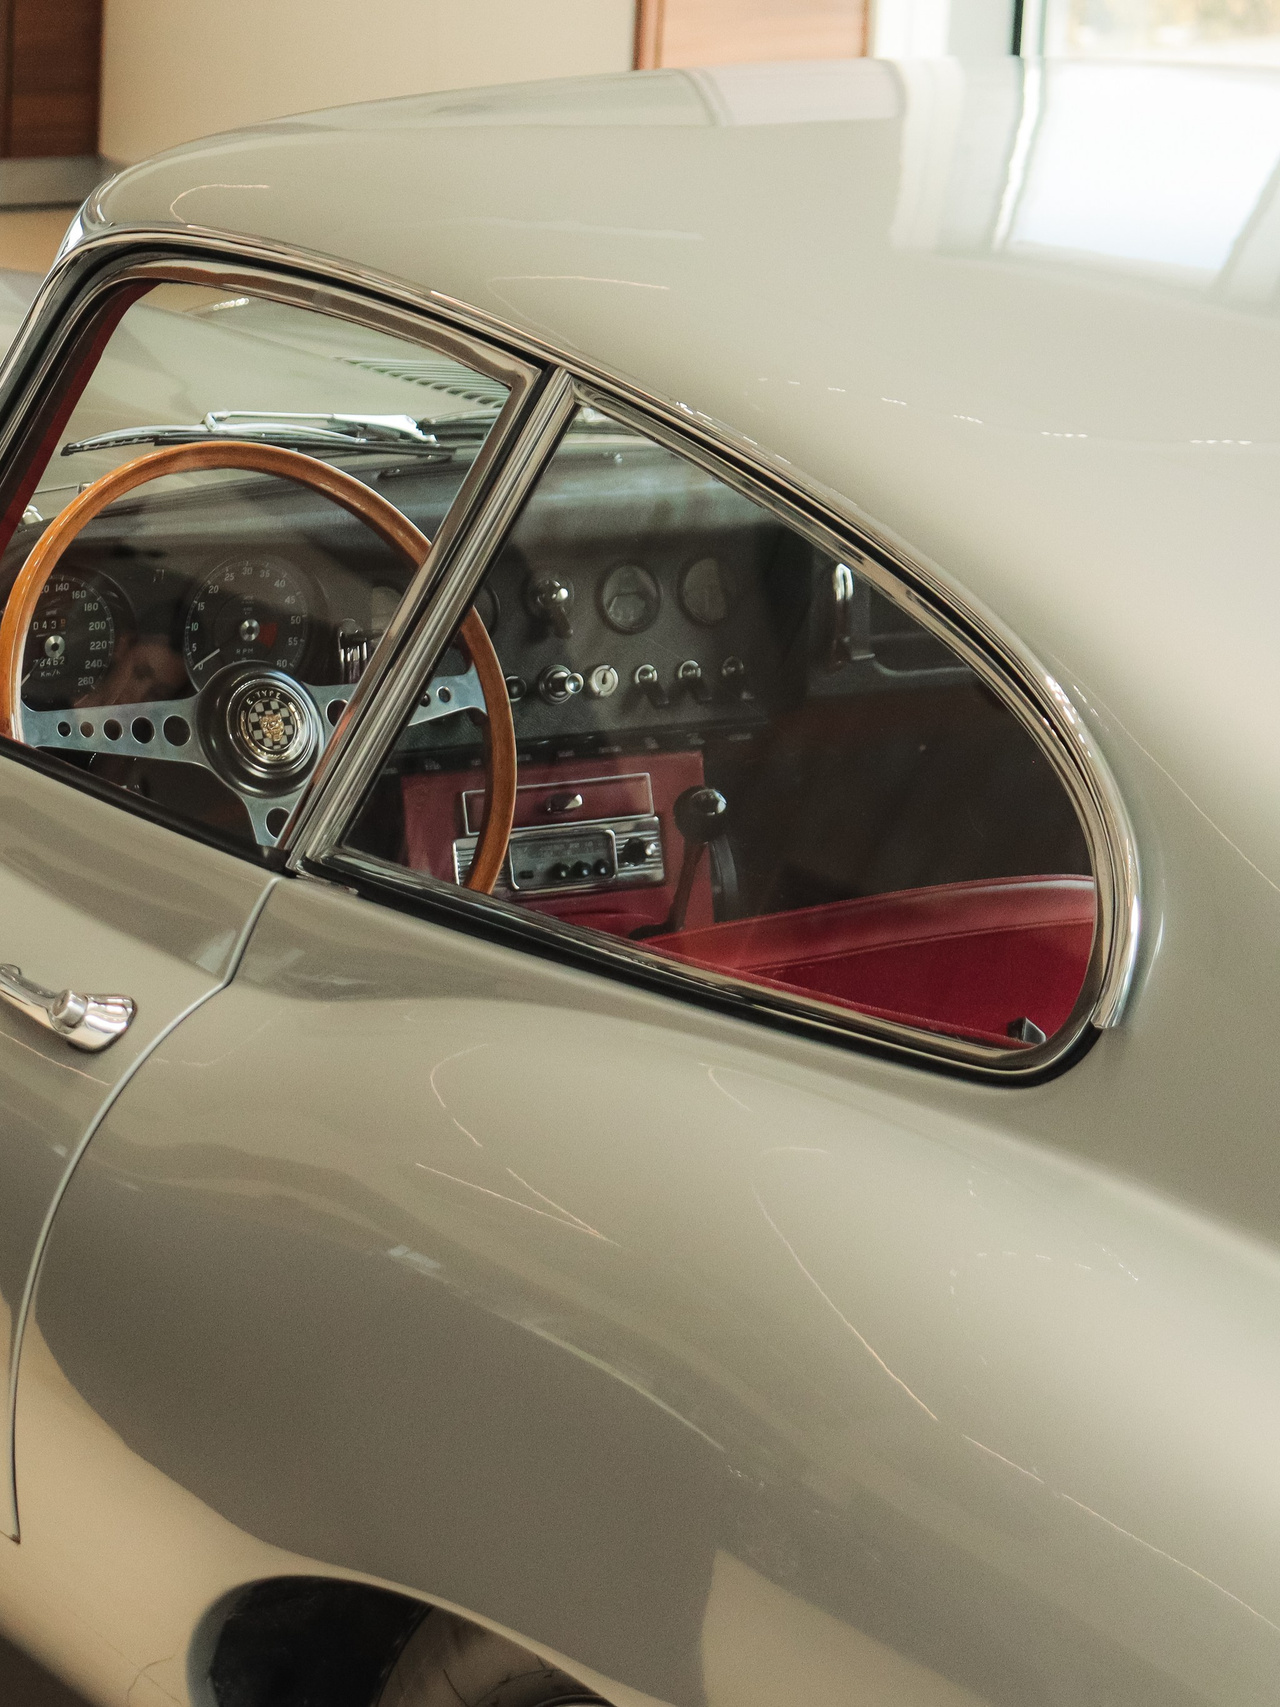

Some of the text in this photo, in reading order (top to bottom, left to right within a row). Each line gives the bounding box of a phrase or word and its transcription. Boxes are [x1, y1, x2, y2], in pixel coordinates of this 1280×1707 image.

[224, 572, 235, 581] 25
[55, 582, 70, 592] 140
[274, 579, 286, 588] 40
[208, 585, 219, 593] 20
[72, 590, 87, 600] 160
[284, 595, 296, 604] 45
[84, 602, 99, 612] 180
[197, 602, 205, 611] 15
[290, 616, 301, 625] 50
[88, 621, 107, 631] 200
[191, 622, 199, 631] 10
[90, 641, 107, 651] 220
[288, 636, 298, 646] 55
[85, 659, 103, 669] 240
[77, 676, 95, 687] 260
